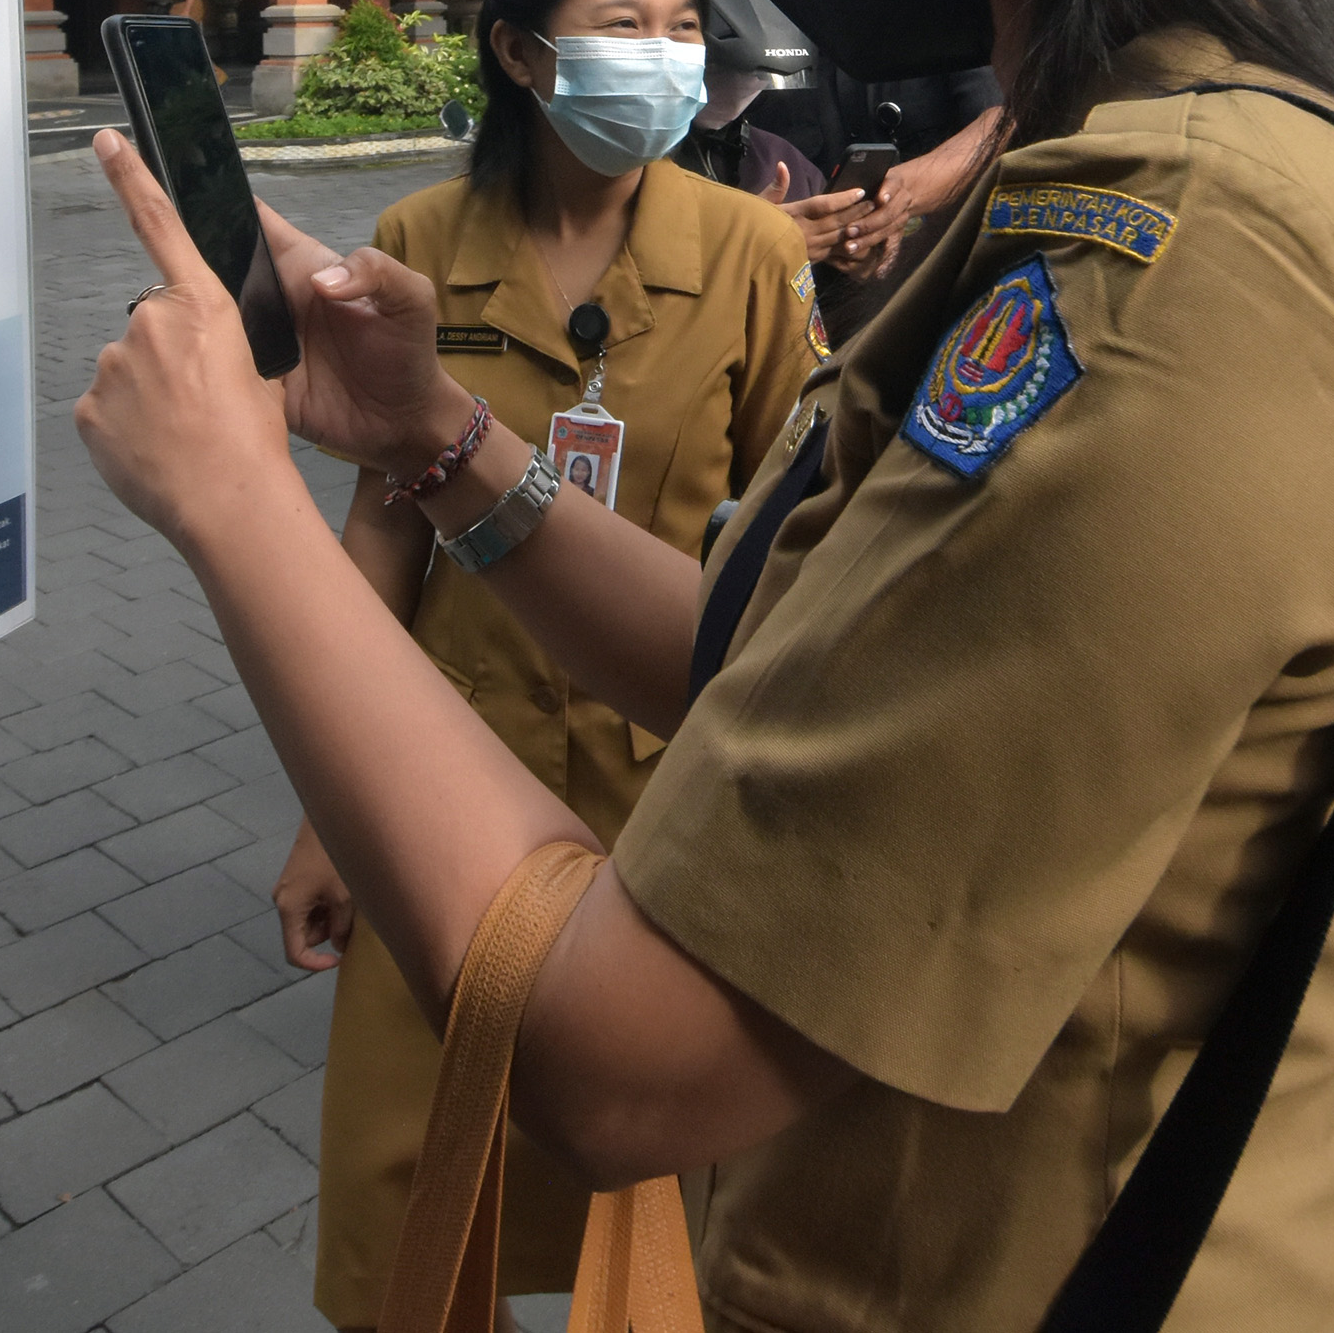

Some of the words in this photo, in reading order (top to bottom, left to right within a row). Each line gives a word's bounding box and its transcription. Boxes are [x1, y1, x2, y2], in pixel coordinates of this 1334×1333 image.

[764, 48, 810, 57] HONDA
[995, 188, 1115, 215] PEMERINTAH
[1117, 204, 1167, 240] KOTA
[1010, 208, 1139, 247] DENPASAR
